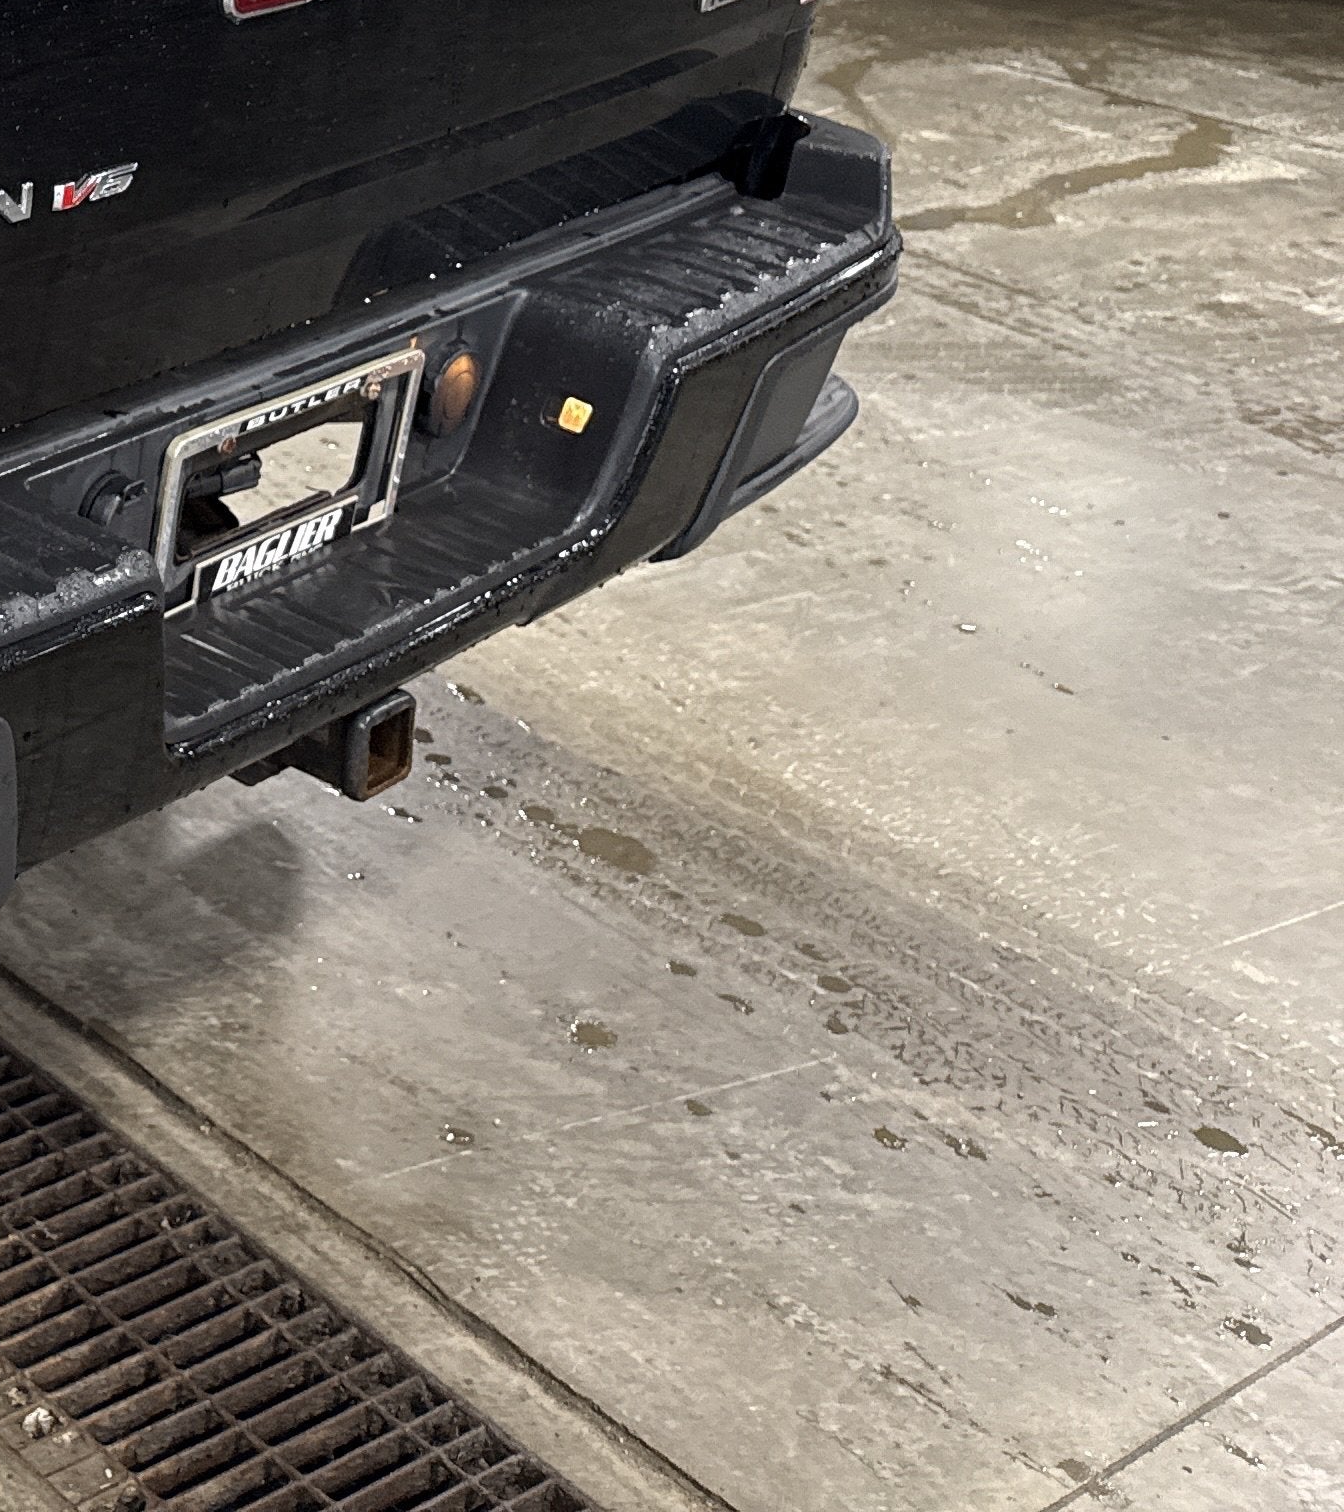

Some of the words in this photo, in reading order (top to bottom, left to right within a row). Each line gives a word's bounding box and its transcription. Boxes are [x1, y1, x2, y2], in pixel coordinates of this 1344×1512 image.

[52, 162, 139, 212] V6
[246, 377, 361, 431] BUTLER
[211, 508, 343, 592] BAGLIER
